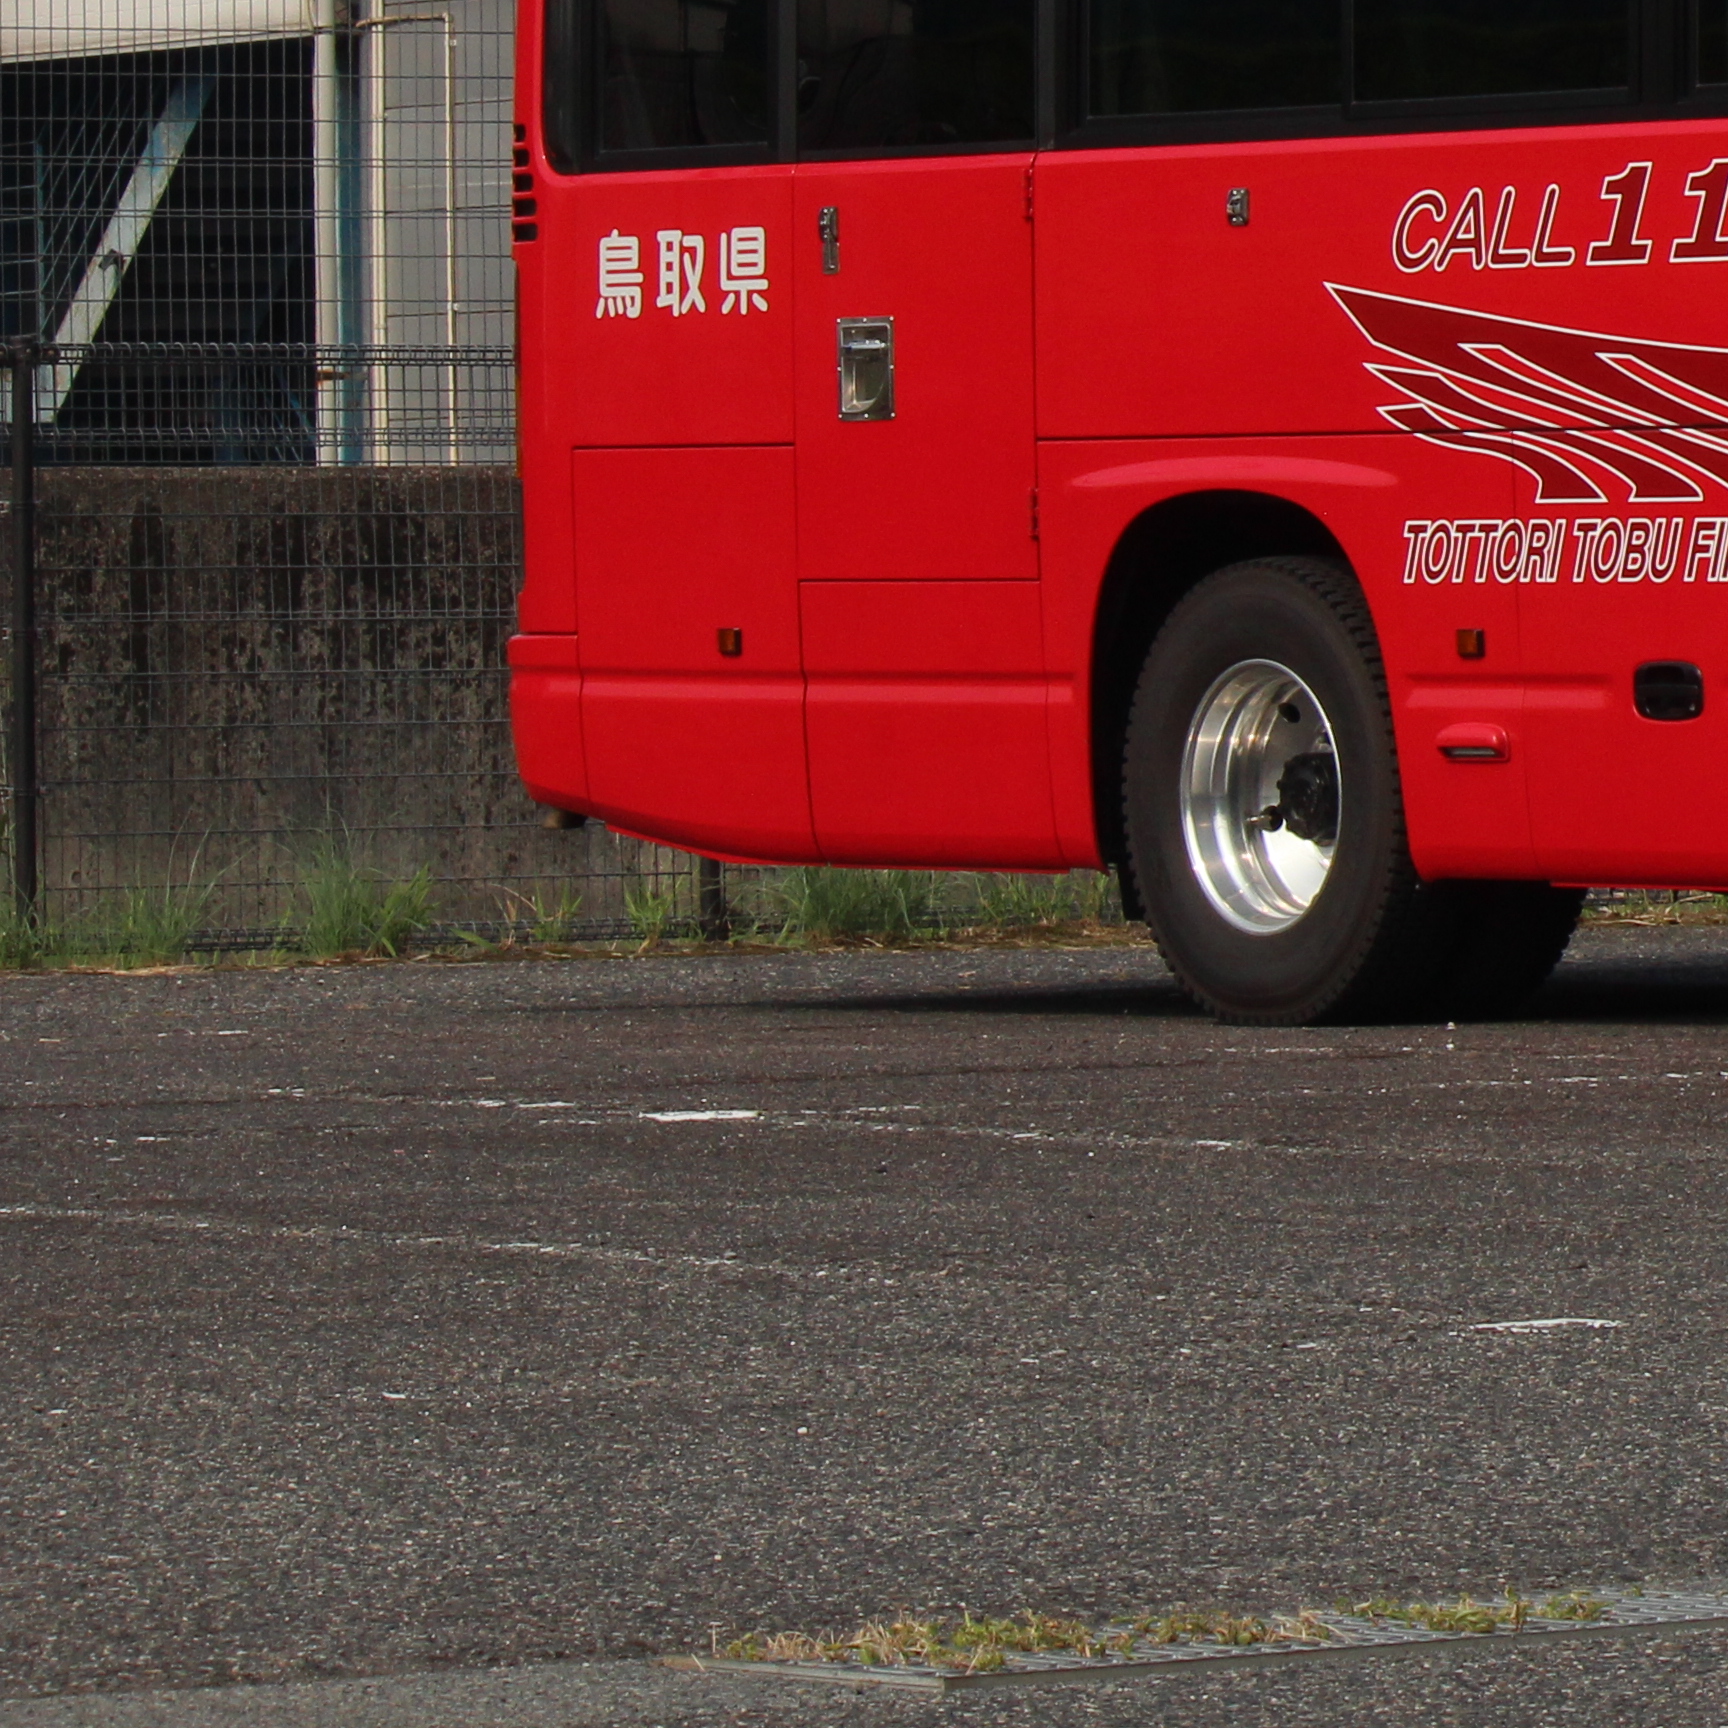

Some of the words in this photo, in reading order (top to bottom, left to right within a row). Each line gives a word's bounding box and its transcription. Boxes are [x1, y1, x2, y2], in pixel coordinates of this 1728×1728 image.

[594, 225, 770, 320] 鳥取県
[1391, 183, 1576, 274] CALL
[1402, 518, 1567, 585] TOTTORI
[1572, 517, 1685, 584] TOBU
